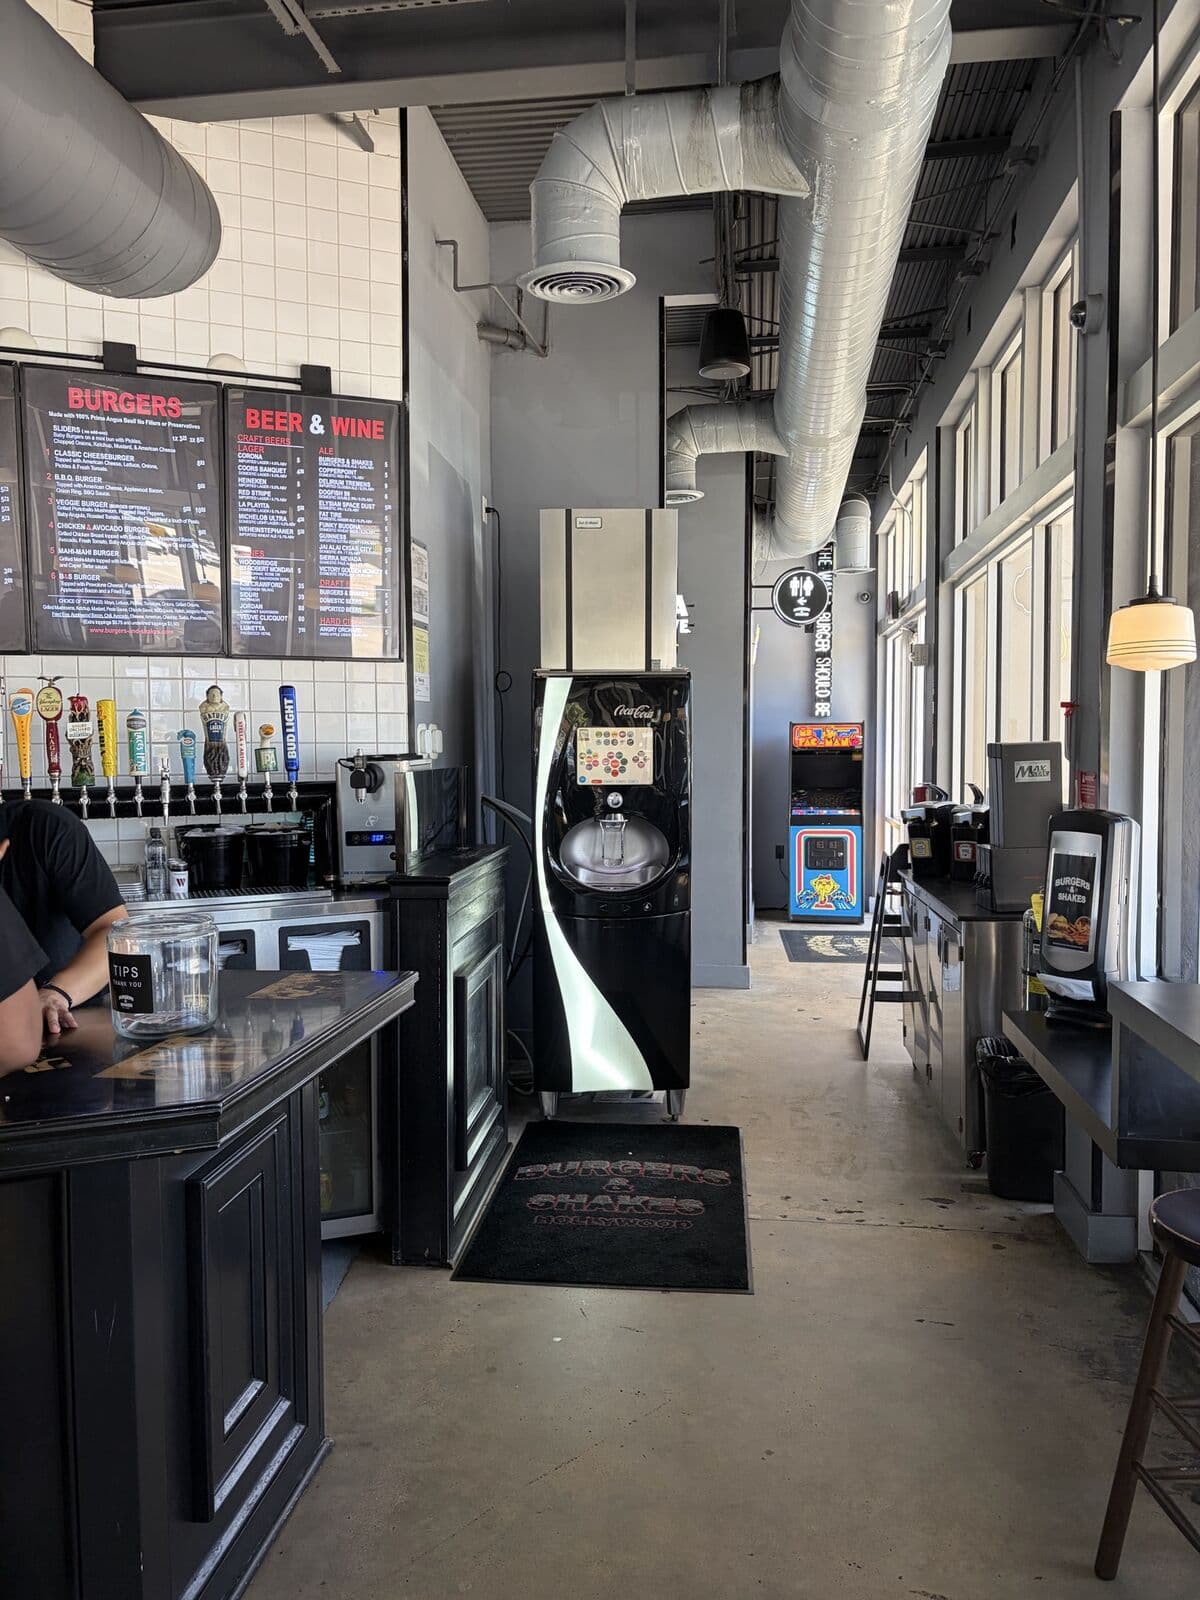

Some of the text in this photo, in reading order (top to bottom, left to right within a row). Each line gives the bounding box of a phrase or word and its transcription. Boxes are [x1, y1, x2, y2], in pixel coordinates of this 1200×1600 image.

[67, 387, 181, 418] BURGERS
[52, 425, 80, 433] SLIDERS
[246, 408, 385, 440] BEER & WINE
[237, 434, 263, 442] CRAFT
[54, 449, 134, 461] CLASSIC CHEESEBURGER
[237, 444, 264, 453] LAGER
[318, 467, 356, 475] COPPERPOINT
[58, 547, 91, 555] MAHI-MAHI
[818, 547, 832, 567] THE
[815, 612, 832, 652] BURGER
[815, 656, 832, 698] SHOULD
[815, 702, 831, 717] BE
[284, 697, 297, 759] BUD LIGHT
[176, 878, 186, 887] W
[1055, 876, 1090, 890] BURGERS
[1057, 892, 1086, 904] SHAKES
[113, 964, 139, 978] TIPS
[514, 1159, 731, 1187] BURGERS
[602, 1177, 634, 1193] &
[526, 1194, 705, 1216] SHAKES
[534, 1215, 694, 1229] HOLLYWOOD
